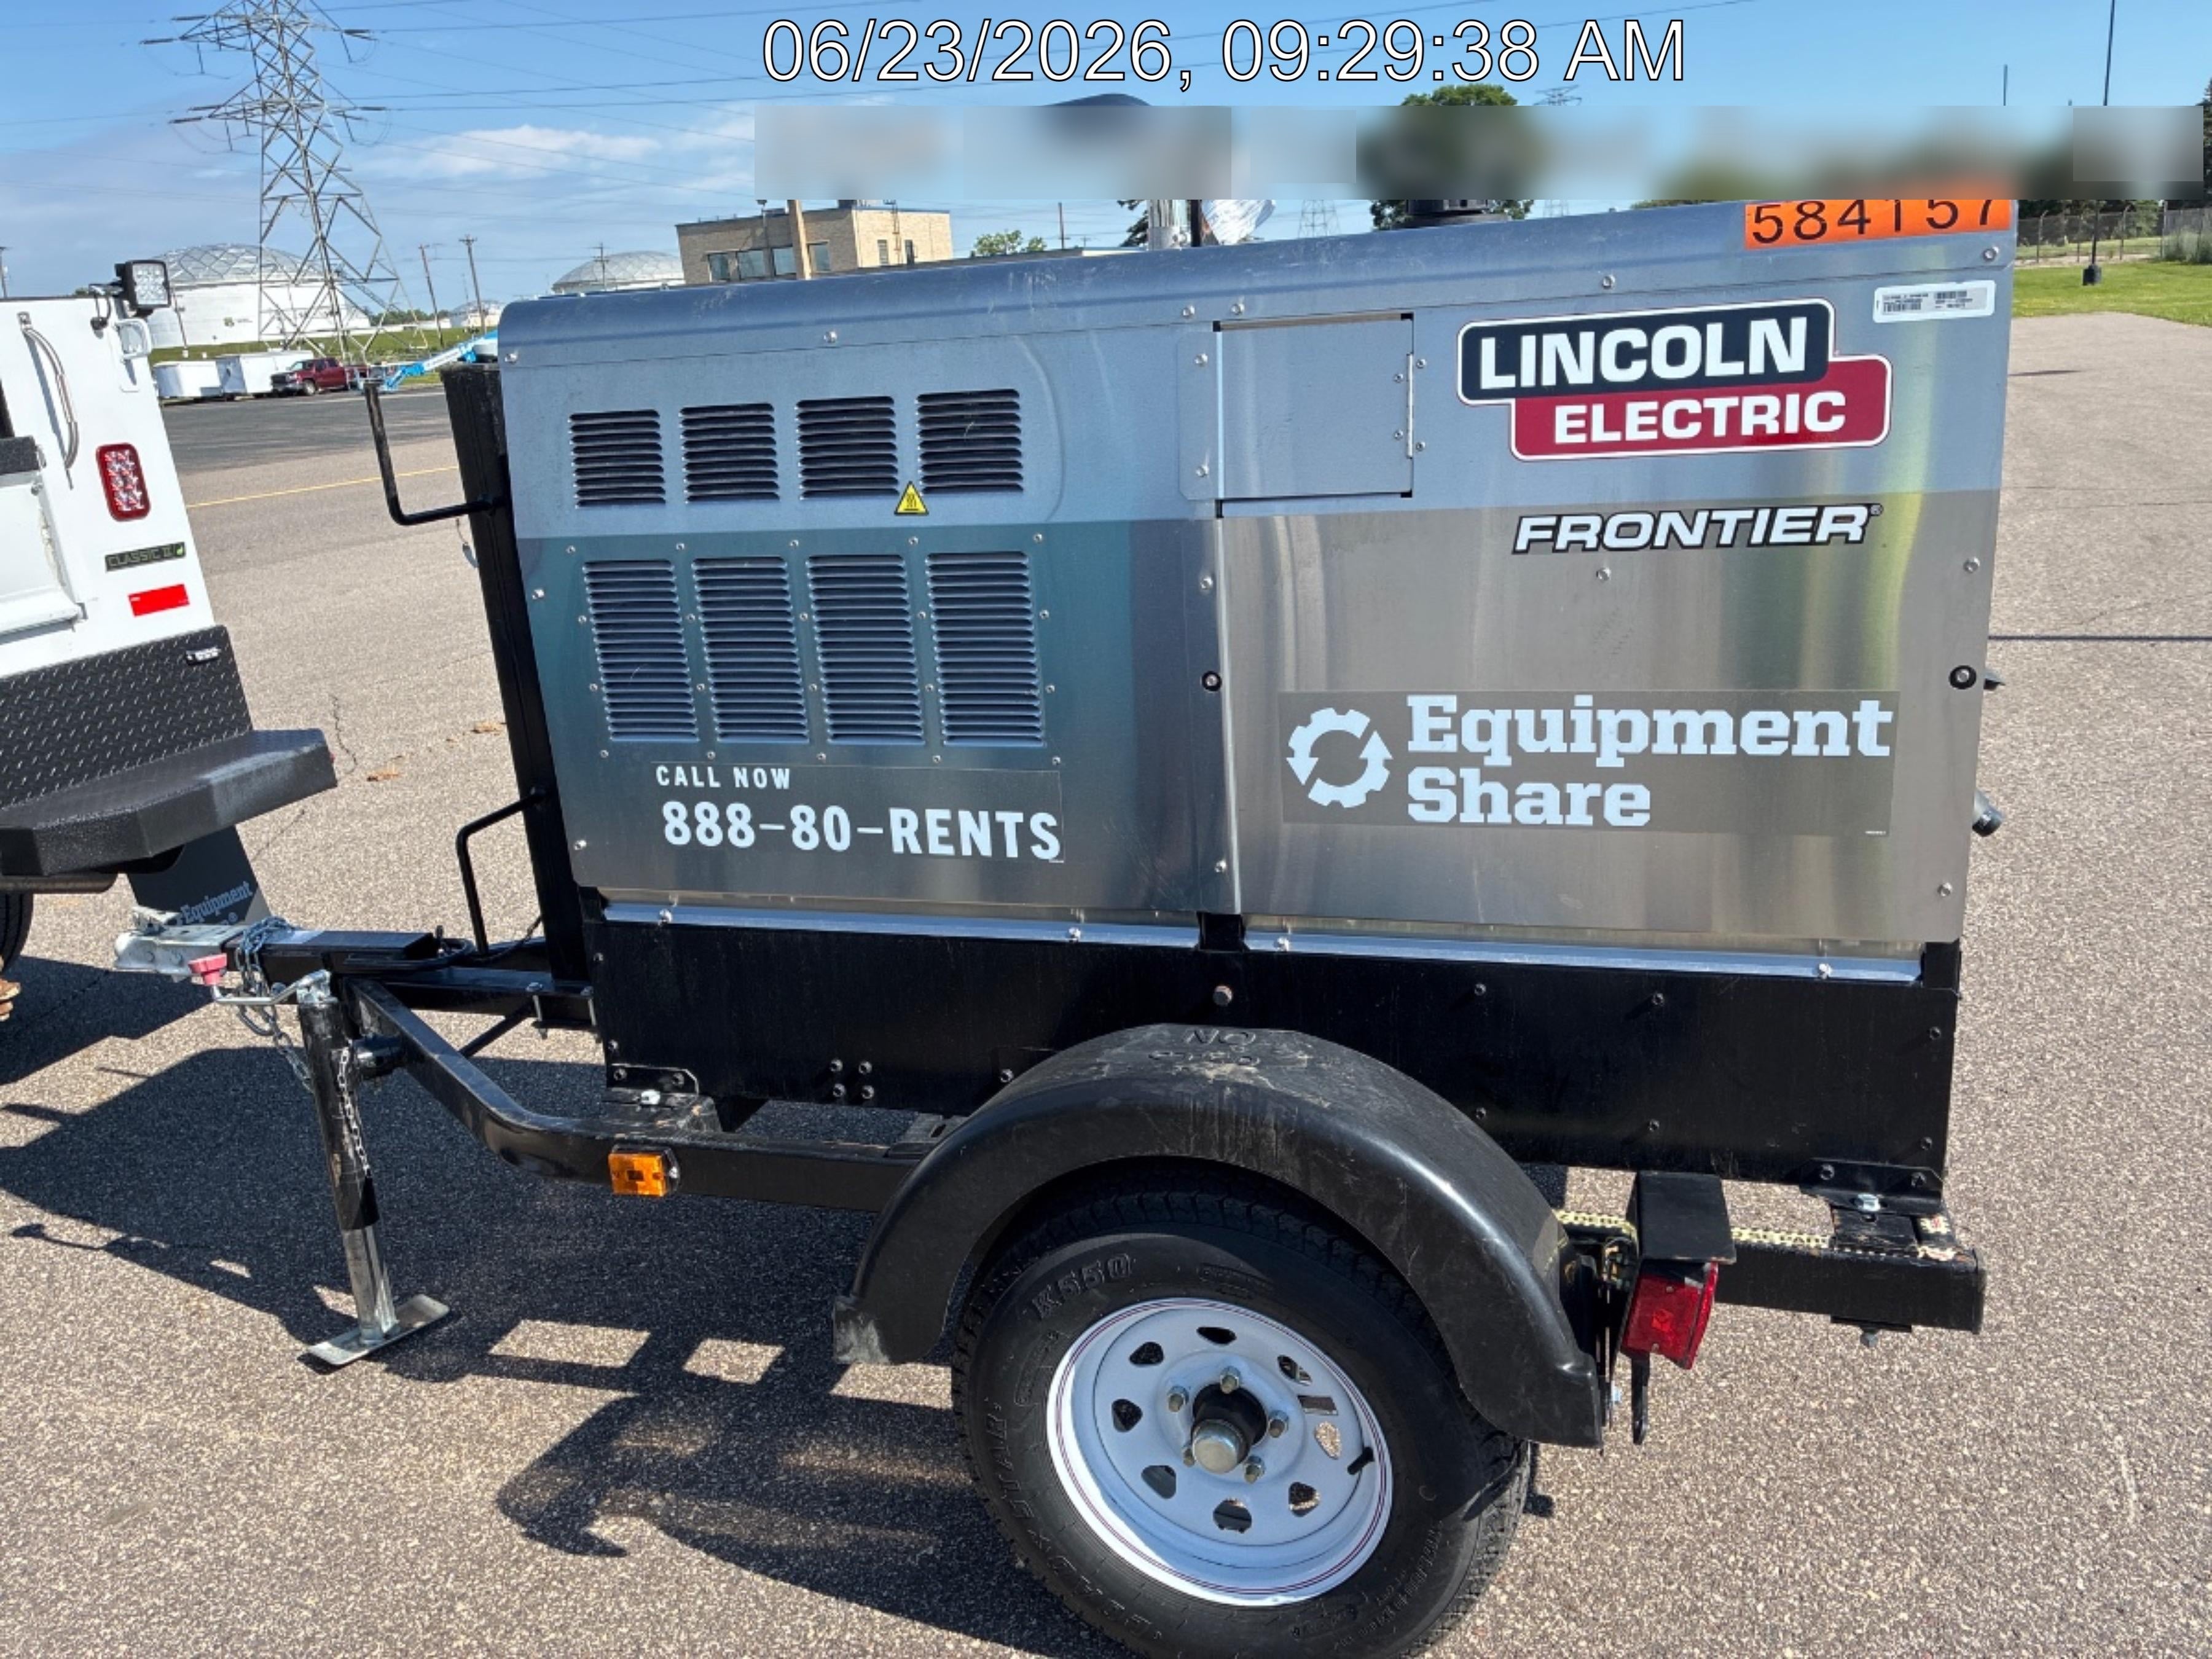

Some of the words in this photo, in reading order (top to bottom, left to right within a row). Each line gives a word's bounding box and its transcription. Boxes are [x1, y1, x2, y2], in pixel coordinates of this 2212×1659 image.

[1480, 316, 1806, 390] LINCOLN
[1555, 390, 1846, 444] ELECTRIC
[108, 547, 161, 567] CLASSIC
[1406, 694, 1894, 767] Equipment
[656, 765, 721, 788] CALL
[733, 766, 791, 790] NOW
[1407, 766, 1651, 827] Share
[662, 801, 1061, 860] 888-80-RENTS
[181, 881, 253, 924] Equipment
[1031, 1253, 1132, 1319] K550
